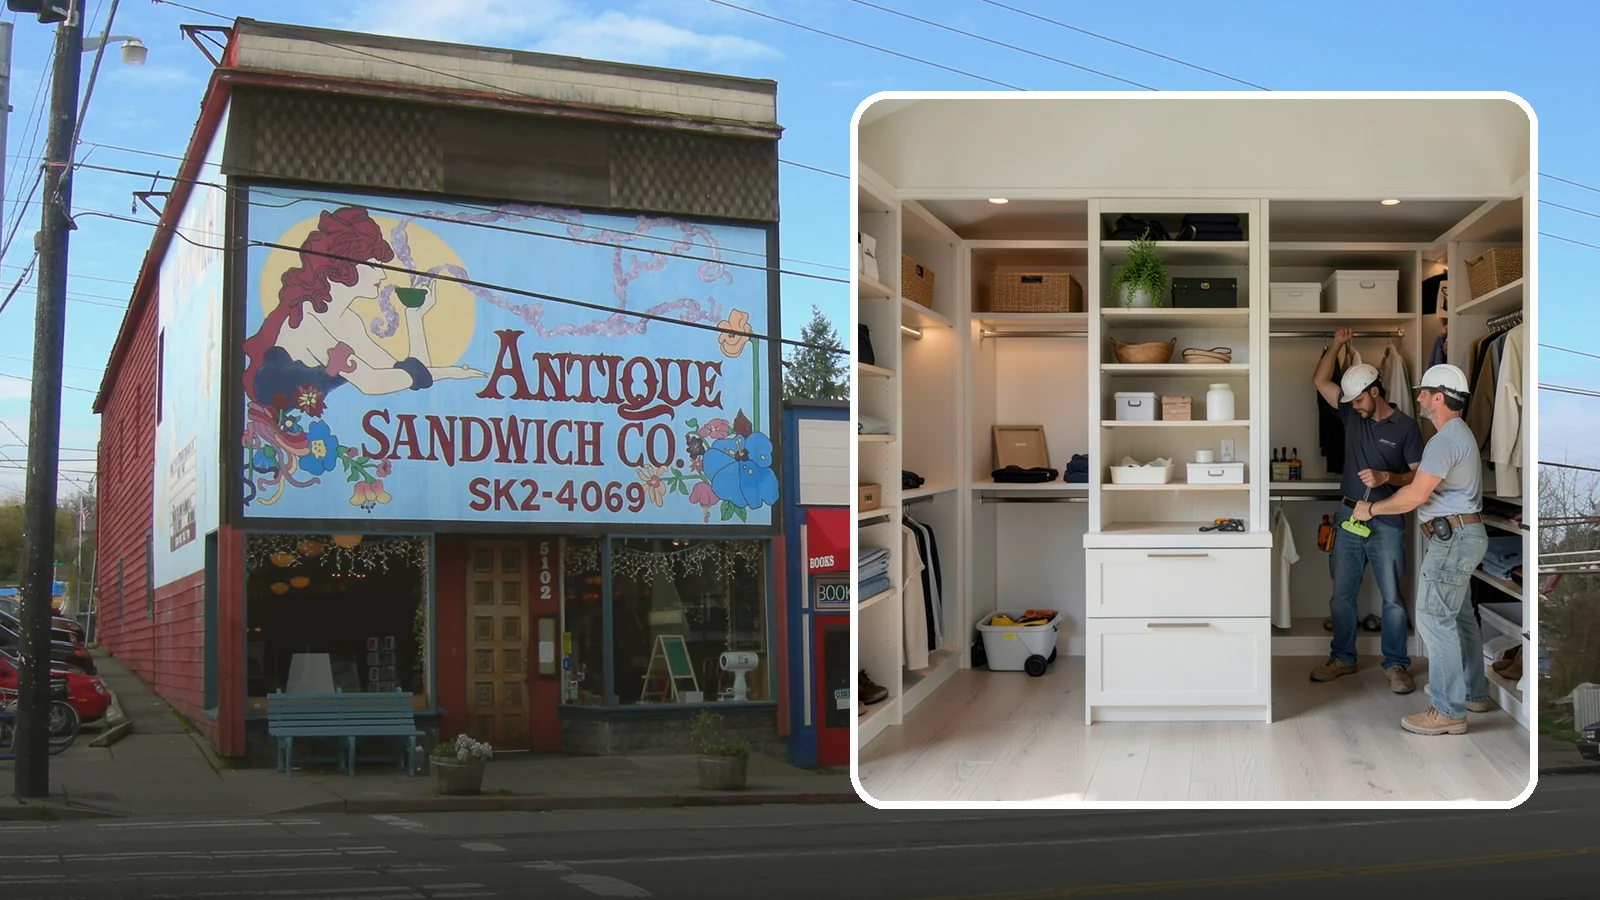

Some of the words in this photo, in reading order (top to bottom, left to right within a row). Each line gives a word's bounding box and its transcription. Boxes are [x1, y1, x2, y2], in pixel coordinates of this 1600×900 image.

[475, 328, 723, 421] ANTIQUE
[360, 408, 604, 467] SANDWICH
[617, 421, 685, 468] CO.
[468, 477, 645, 513] SK2-4069
[539, 541, 552, 600] 5102
[809, 555, 835, 569] BOOKS
